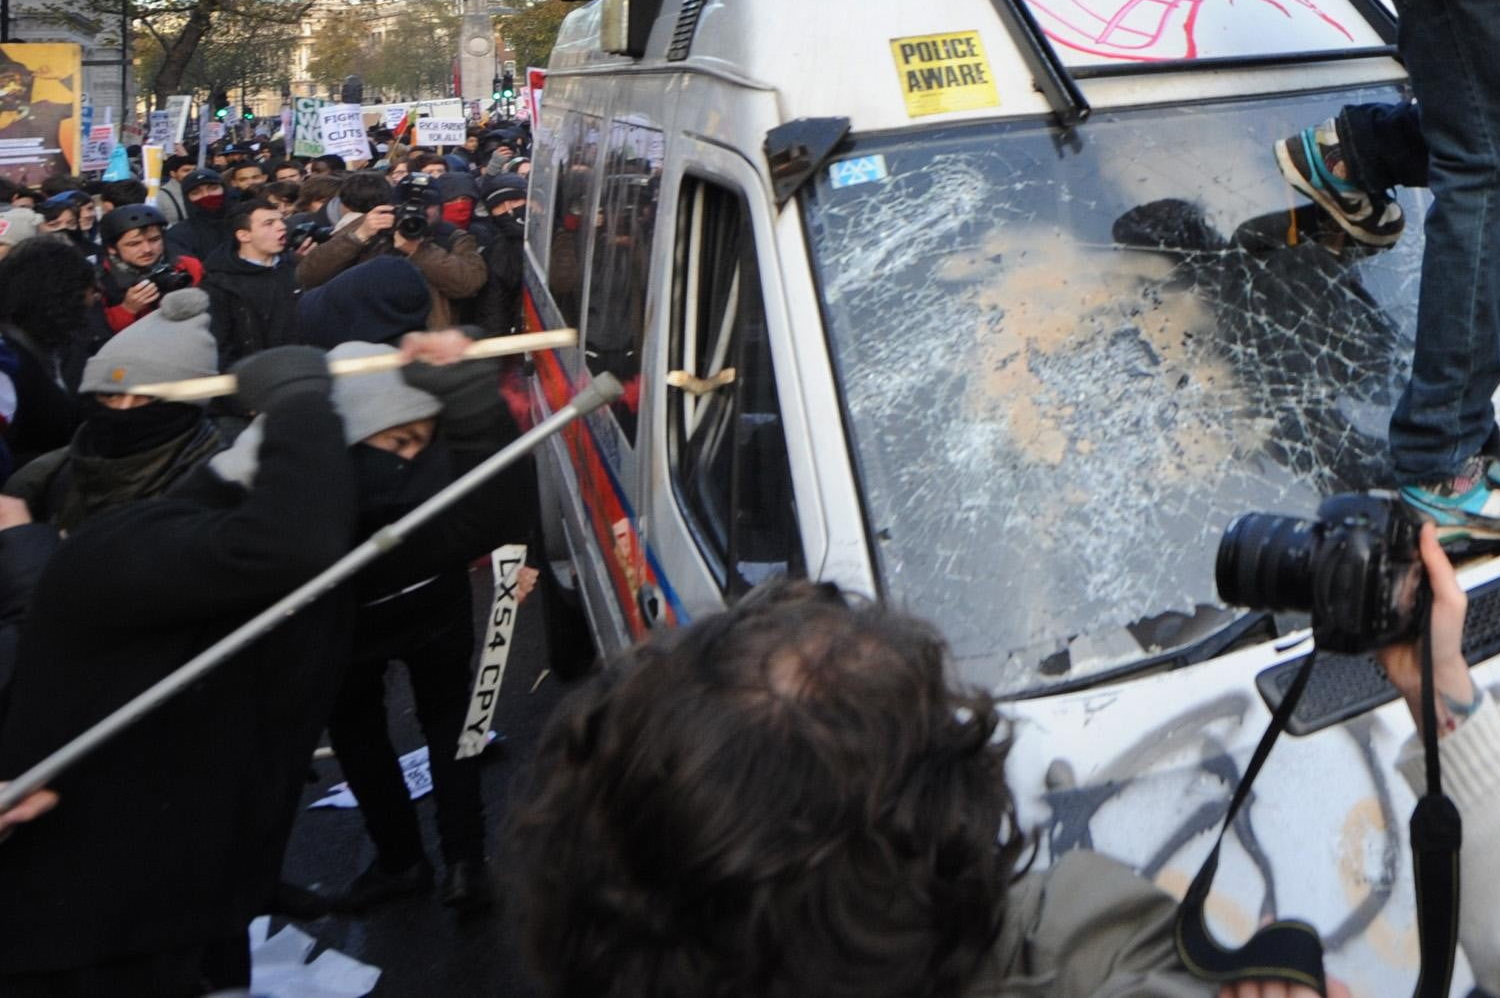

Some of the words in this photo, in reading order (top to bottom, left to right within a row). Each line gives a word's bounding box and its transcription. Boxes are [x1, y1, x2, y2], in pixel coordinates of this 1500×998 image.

[900, 37, 980, 64] POLICE
[907, 62, 989, 93] AWARE
[324, 112, 361, 124] FIGHT
[328, 128, 362, 142] CUTS
[488, 558, 521, 651] LX54
[467, 664, 500, 735] CPY
